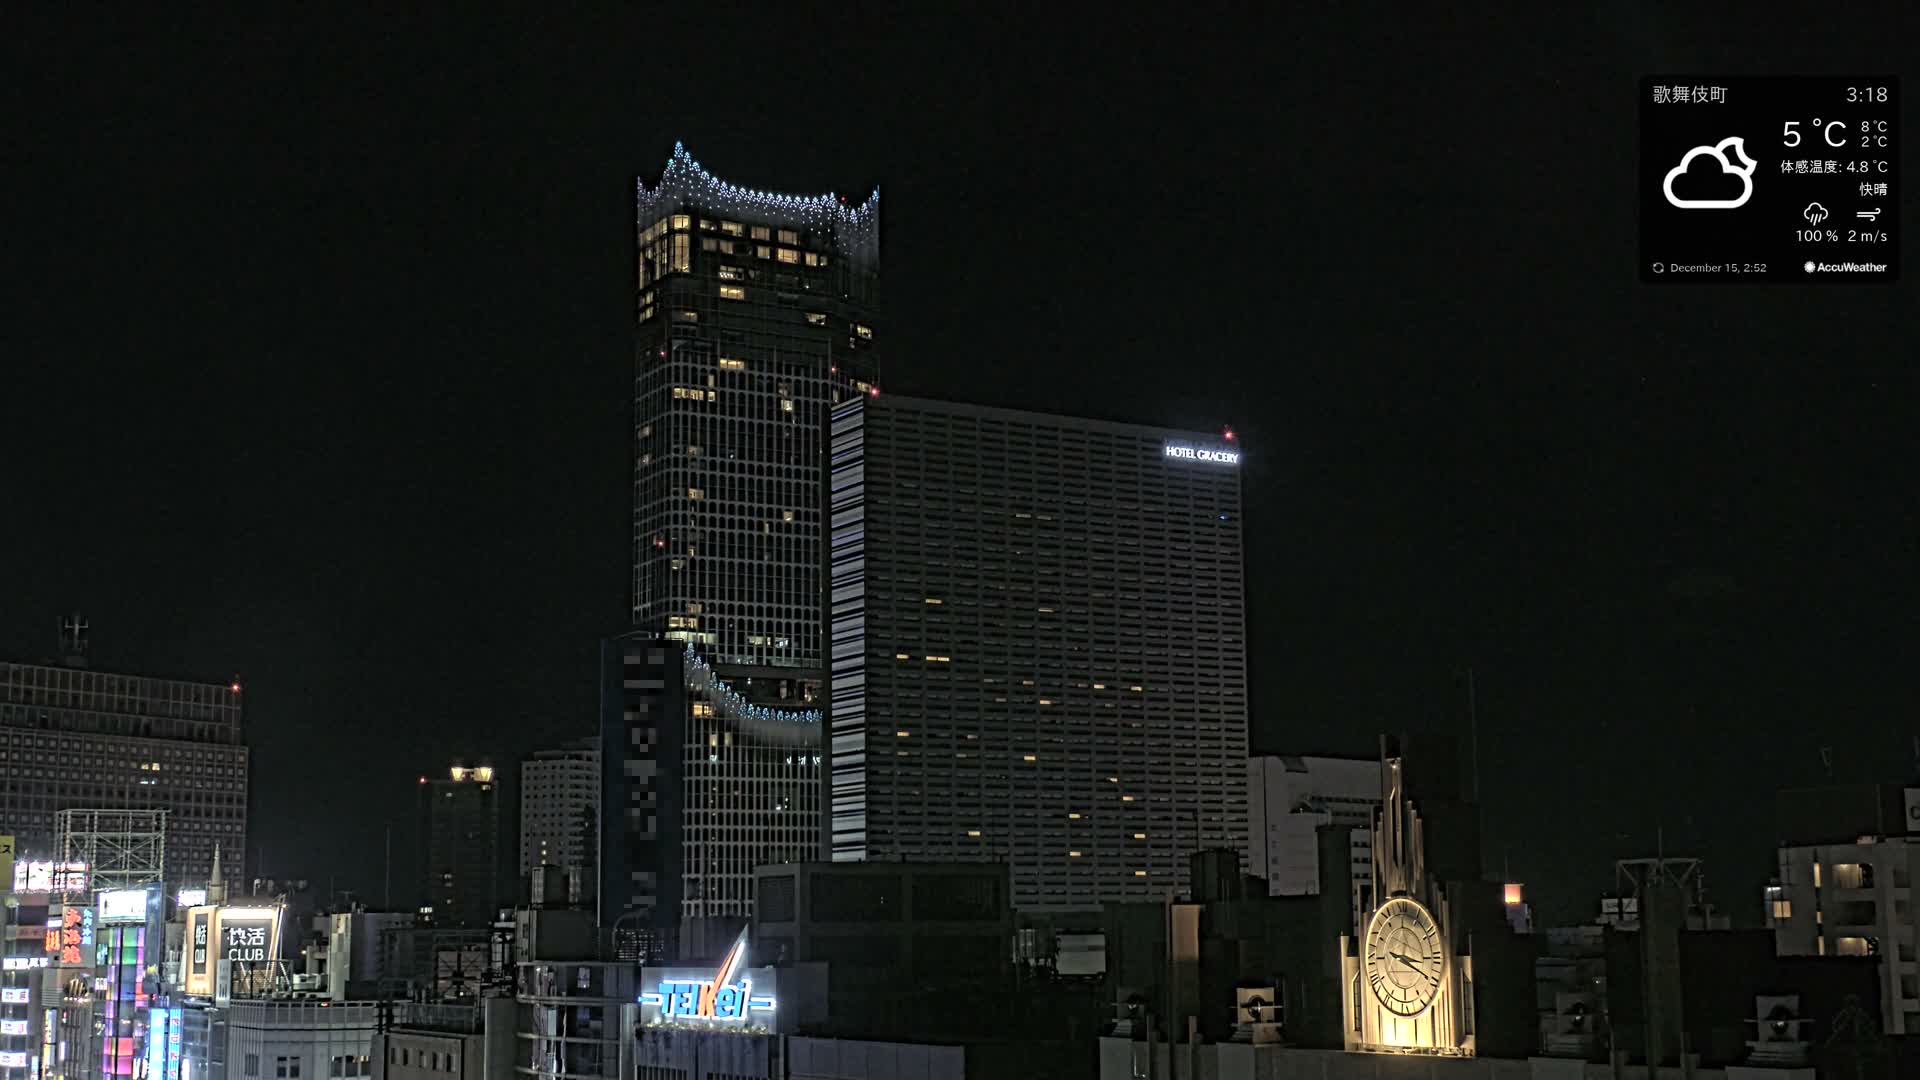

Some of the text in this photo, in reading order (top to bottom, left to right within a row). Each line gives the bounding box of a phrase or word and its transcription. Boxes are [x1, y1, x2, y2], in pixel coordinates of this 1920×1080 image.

[1166, 446, 1239, 463] HOTEL GRACERY
[228, 927, 266, 946] 快活
[228, 948, 264, 961] CLUB
